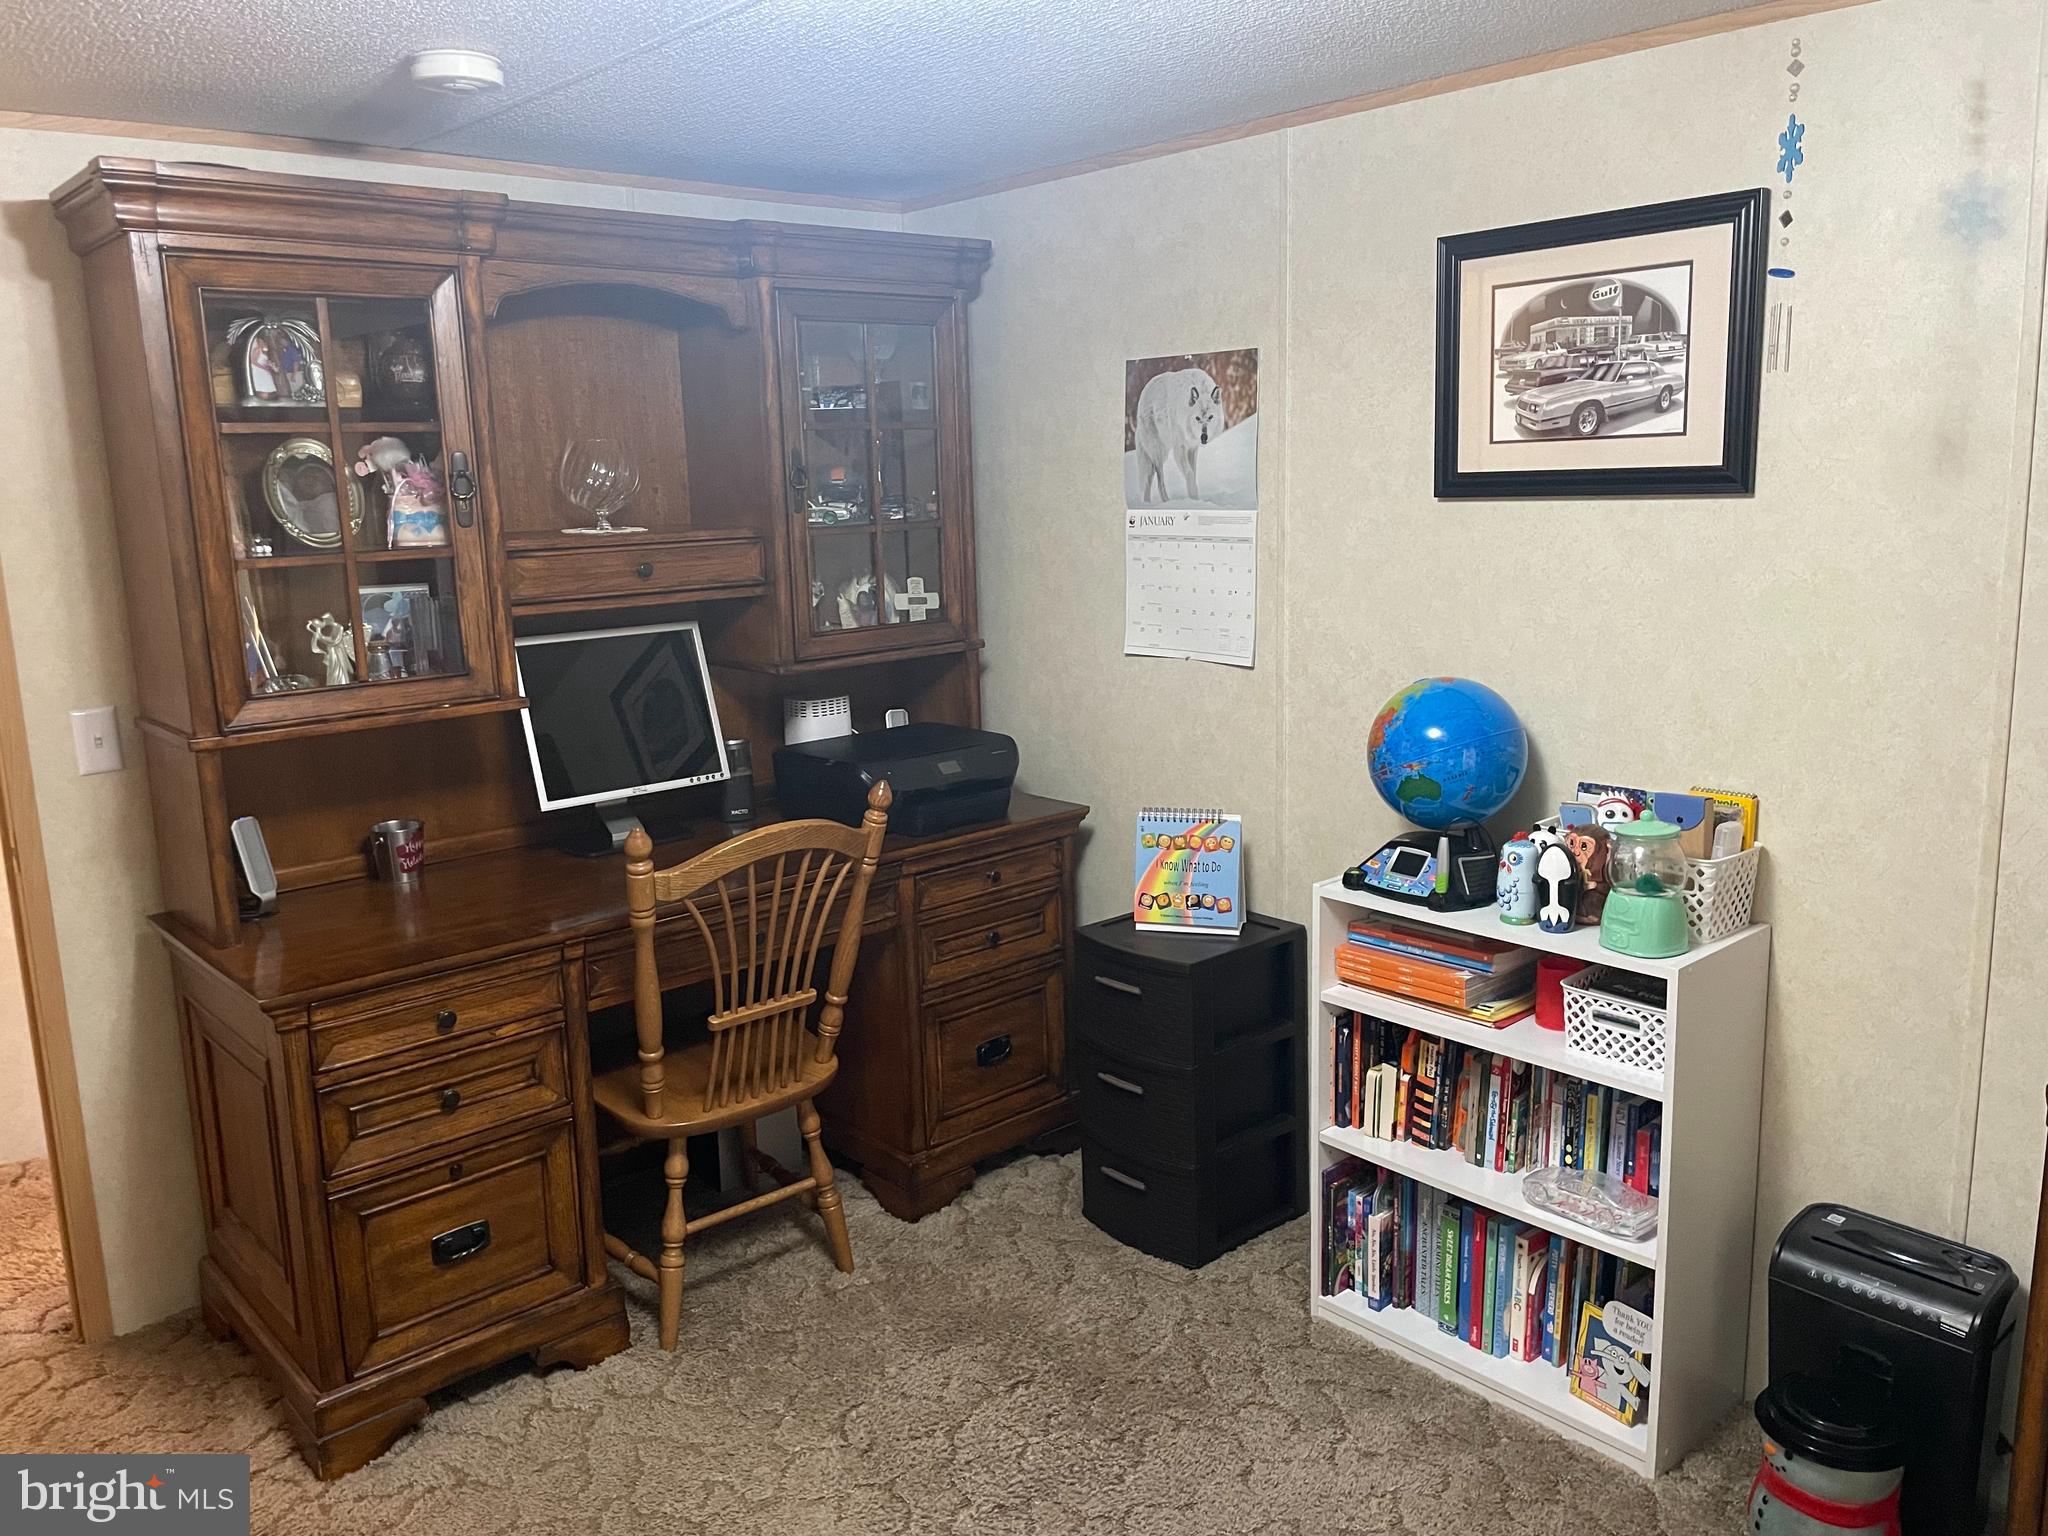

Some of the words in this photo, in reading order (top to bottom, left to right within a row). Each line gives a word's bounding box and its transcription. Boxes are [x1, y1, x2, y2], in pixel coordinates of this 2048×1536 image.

[1591, 286, 1619, 300] Gulf
[1140, 516, 1176, 527] JANUARY
[1160, 860, 1179, 871] Know
[1181, 859, 1200, 872] What
[1202, 861, 1210, 872] to
[1211, 861, 1222, 872] Do
[1420, 1221, 1428, 1270] ENCHANTED
[1446, 1228, 1454, 1254] SWEET
[1445, 1253, 1453, 1279] DREAM
[1443, 1278, 1452, 1305] KISSES
[1513, 1289, 1522, 1312] ABC
[1613, 1306, 1635, 1325] Thank
[1614, 1317, 1625, 1327] for
[1625, 1322, 1646, 1339] being
[1618, 1331, 1645, 1346] reader!
